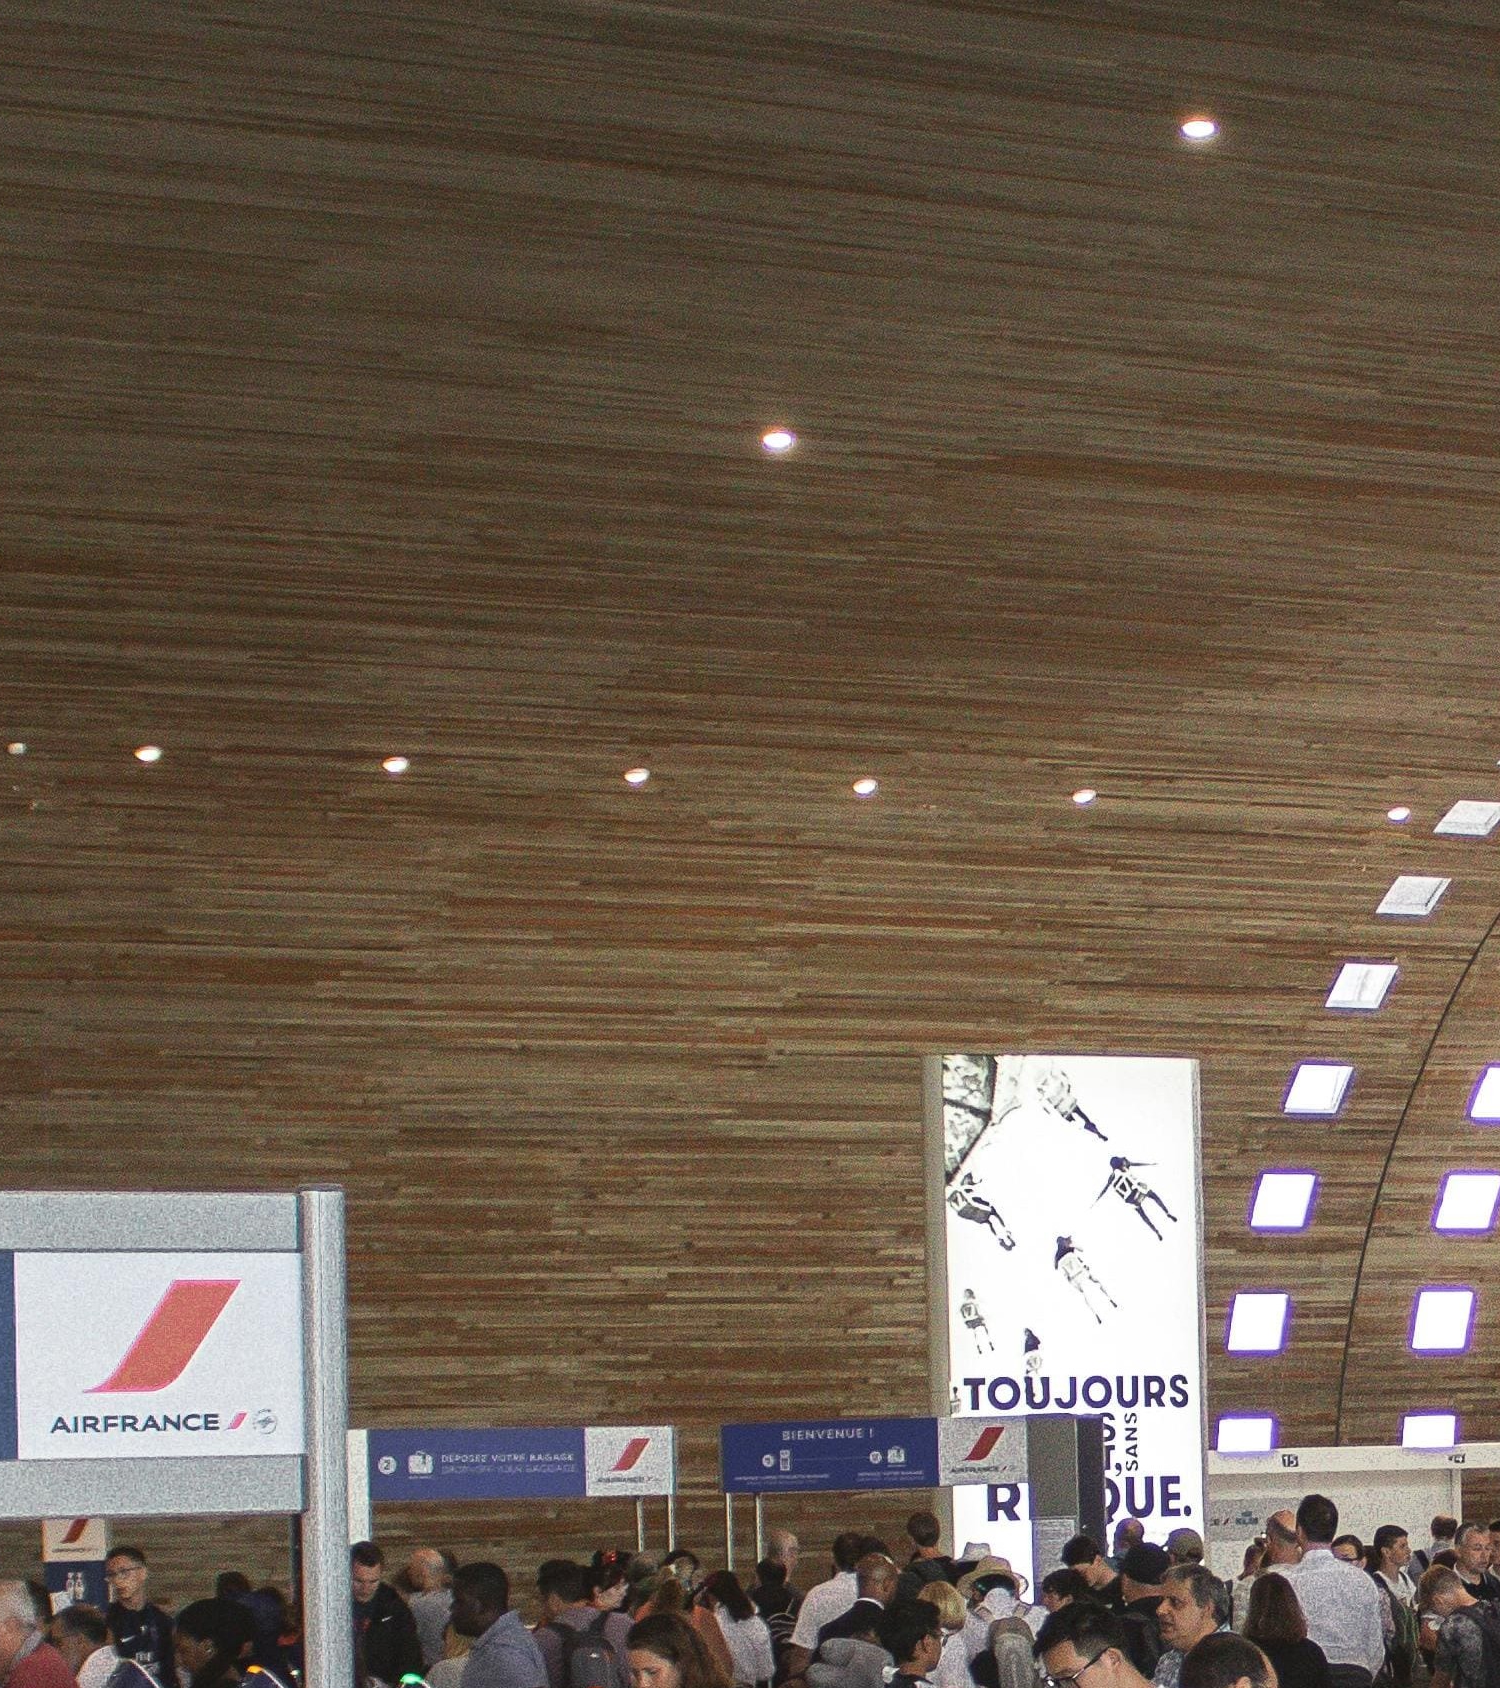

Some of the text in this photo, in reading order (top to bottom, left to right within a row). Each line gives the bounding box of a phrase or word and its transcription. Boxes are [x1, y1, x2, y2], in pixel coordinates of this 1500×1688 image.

[963, 1375, 1189, 1411] TOUJOURS
[50, 1413, 220, 1434] AIRFRANCE
[782, 1429, 864, 1441] BIENVENUE
[1124, 1412, 1139, 1471] SANS
